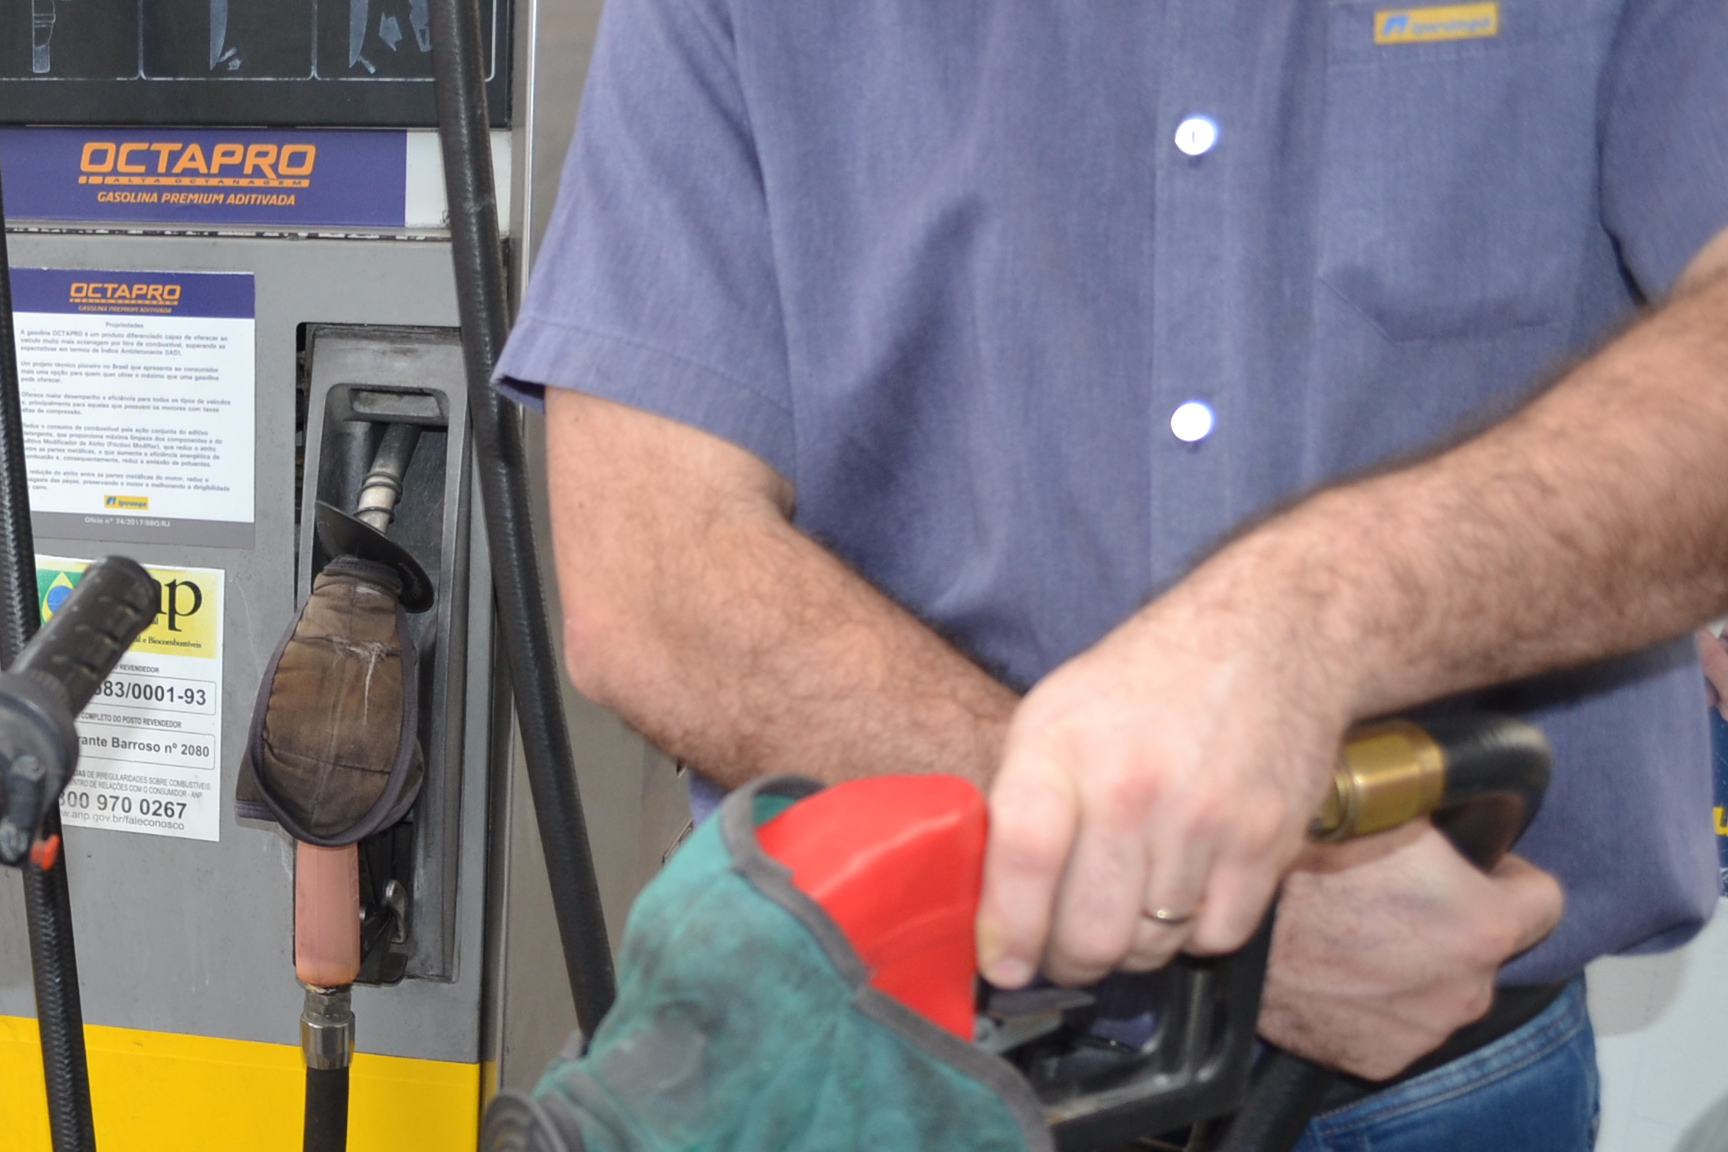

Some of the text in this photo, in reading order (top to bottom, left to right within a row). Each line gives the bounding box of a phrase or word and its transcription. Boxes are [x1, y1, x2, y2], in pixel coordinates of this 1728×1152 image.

[80, 142, 316, 179] OCTAPRO
[97, 191, 295, 205] GASOLINA PREMIUM ADITIVADA
[70, 283, 181, 300] OCTAPRO
[148, 636, 202, 648] Biocombustíveis
[120, 664, 160, 673] REVENDEDOR
[81, 713, 111, 722] COMPLETO
[123, 715, 141, 725] POSTO
[143, 717, 182, 728] REVENDEDOR
[79, 736, 107, 747] rante
[112, 737, 160, 752] Barroso
[181, 744, 210, 757] 2080
[96, 772, 148, 784] IRREGULARIDADES
[149, 777, 167, 786] SOBRE
[98, 781, 128, 792] RELAÇÕES
[129, 784, 142, 792] COM
[149, 787, 186, 797] CONSUMIDOR
[97, 794, 132, 814] 970
[140, 798, 187, 819] 0267
